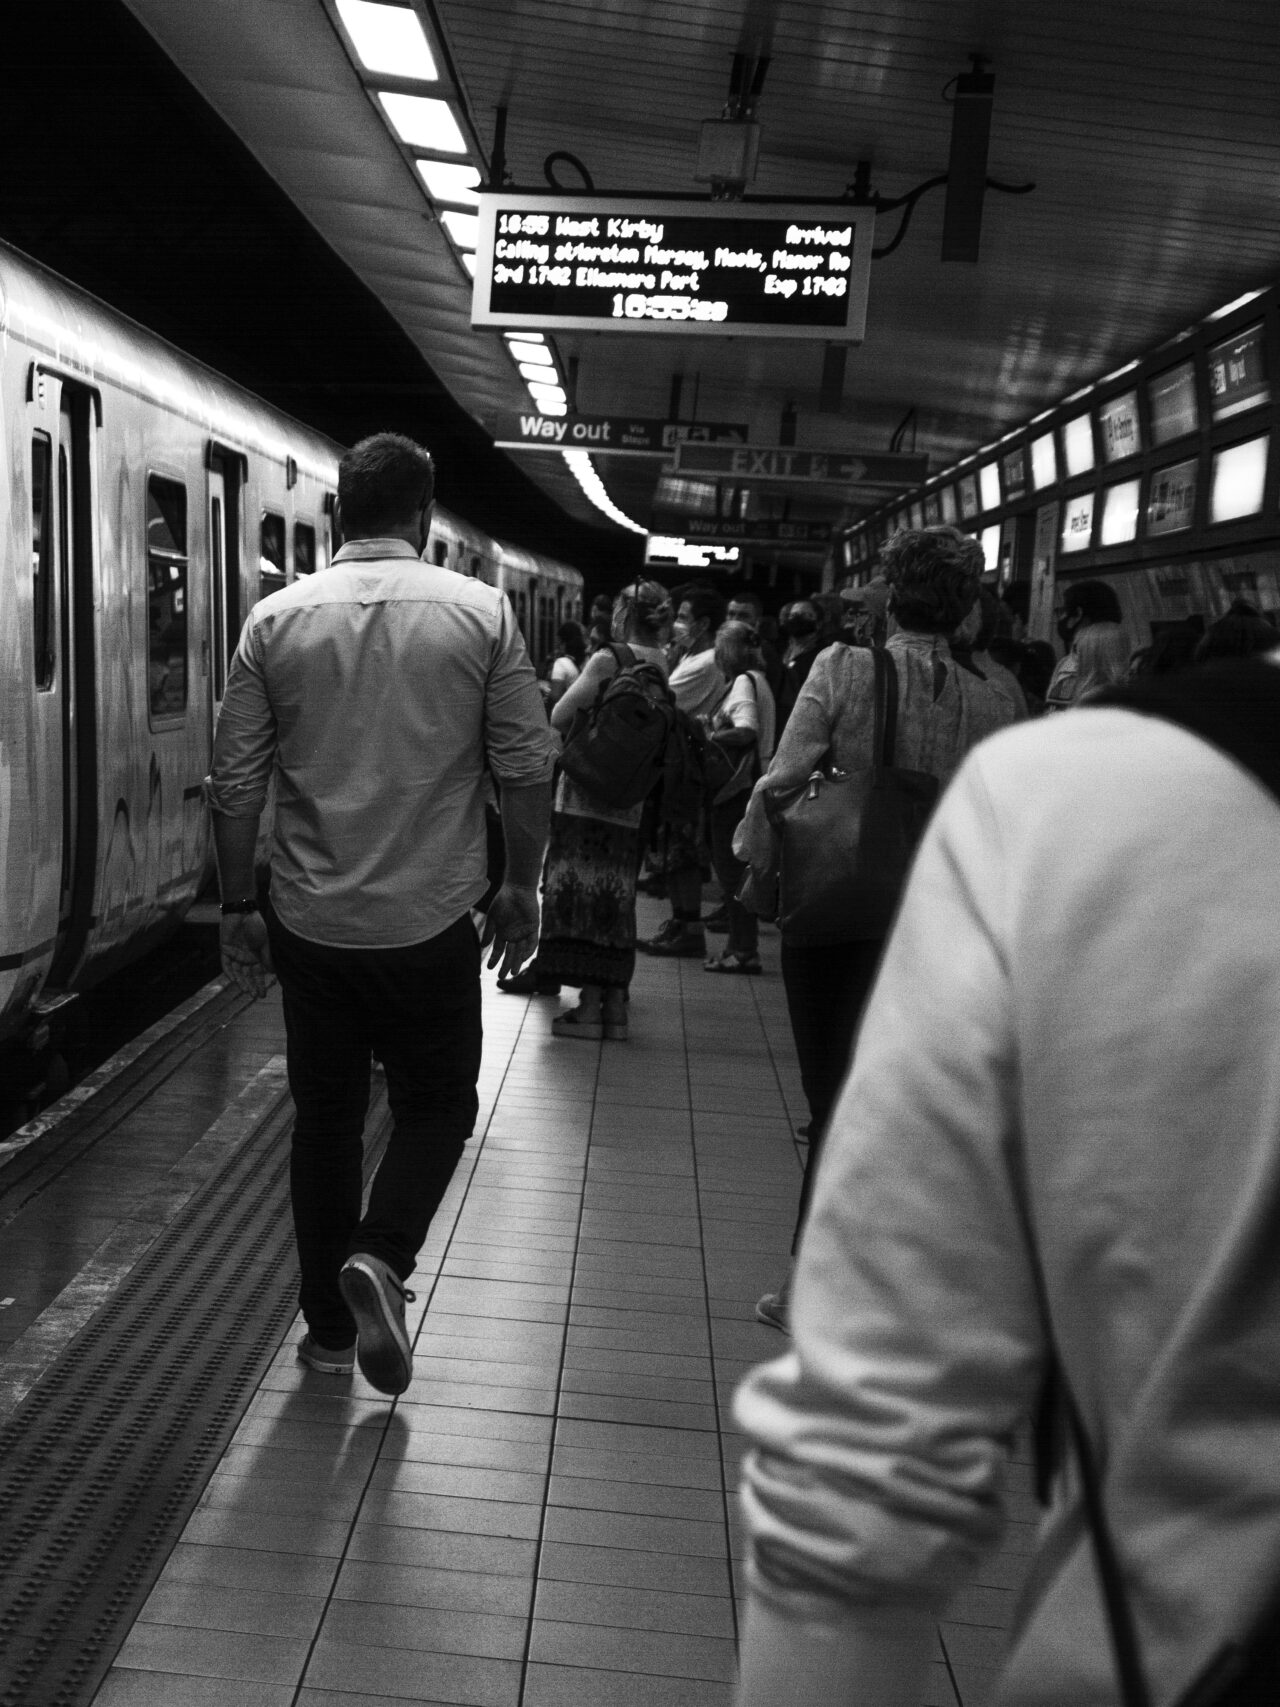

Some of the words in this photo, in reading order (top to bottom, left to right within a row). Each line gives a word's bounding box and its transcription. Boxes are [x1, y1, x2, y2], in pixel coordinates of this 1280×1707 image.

[555, 216, 600, 237] West
[607, 218, 664, 244] Kirby
[786, 225, 852, 246] Arrived
[495, 239, 549, 264] Calling
[772, 250, 825, 270] Manor
[575, 267, 656, 289] Ellesmere
[660, 270, 700, 291] Port
[764, 274, 798, 298] Exp
[520, 415, 568, 441] Way
[572, 421, 611, 441] out
[731, 449, 799, 475] EXIT
[688, 519, 719, 535] Way
[722, 522, 746, 534] out
